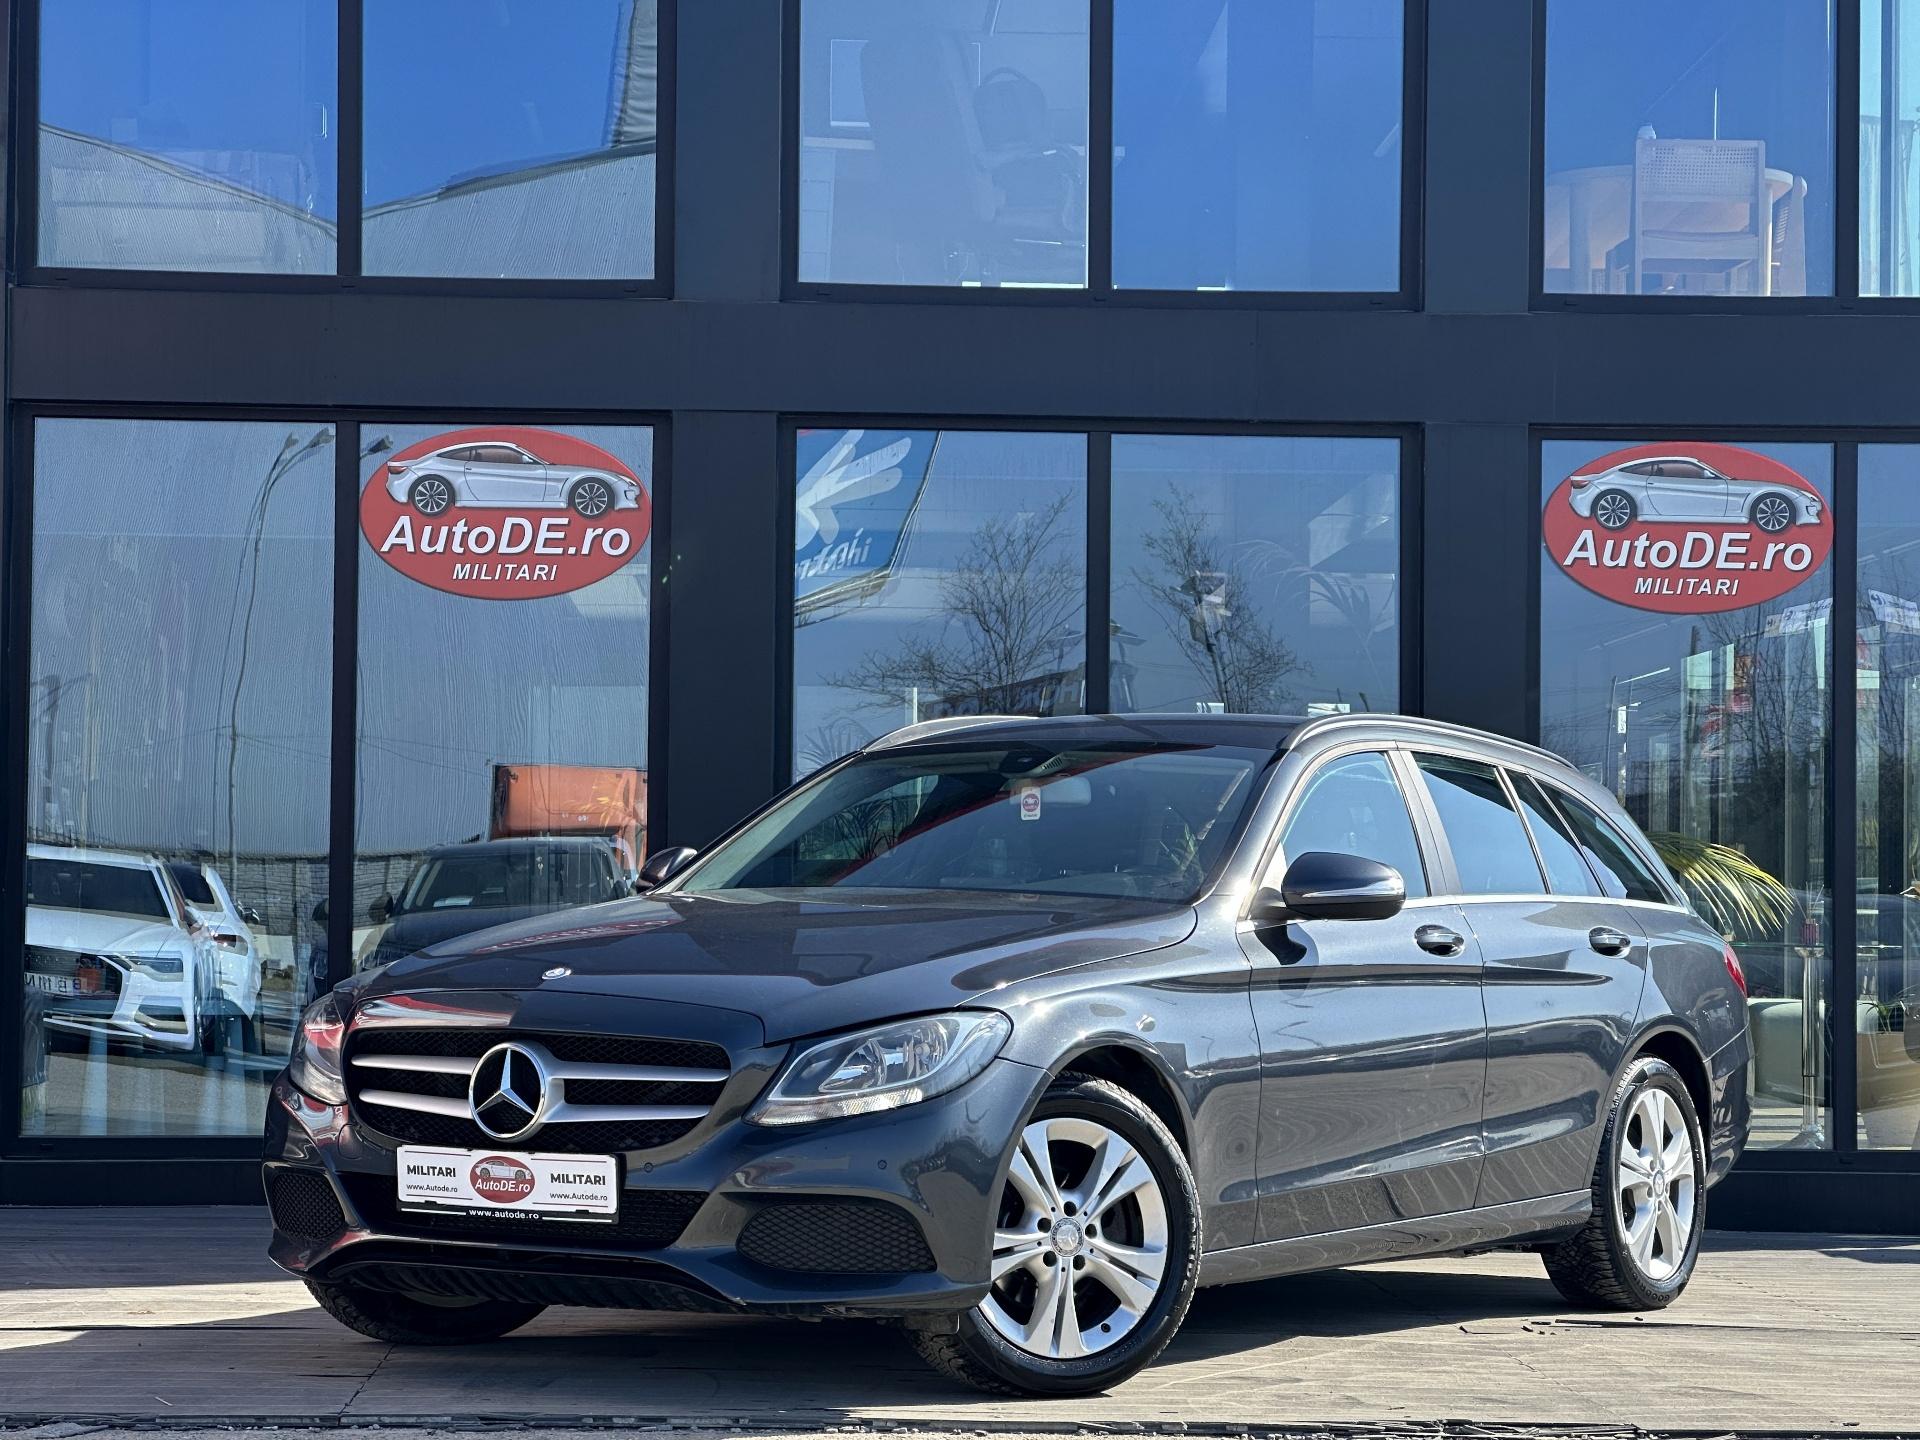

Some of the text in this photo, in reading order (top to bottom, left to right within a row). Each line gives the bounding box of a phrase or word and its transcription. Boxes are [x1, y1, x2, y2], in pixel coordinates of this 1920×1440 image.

[380, 515, 630, 556] AutoDE.ro
[1563, 529, 1812, 571] AutoDE.ro
[452, 563, 558, 581] MILITARI
[1634, 577, 1739, 595] MILITARI
[406, 1164, 456, 1178] MILITARI
[475, 1178, 531, 1193] AutoDE.ro
[550, 1173, 606, 1186] MILITARI
[406, 1183, 458, 1193] www.Autode.ro
[549, 1191, 608, 1201] www.Autode.ro
[468, 1208, 540, 1220] www.autode.ro
